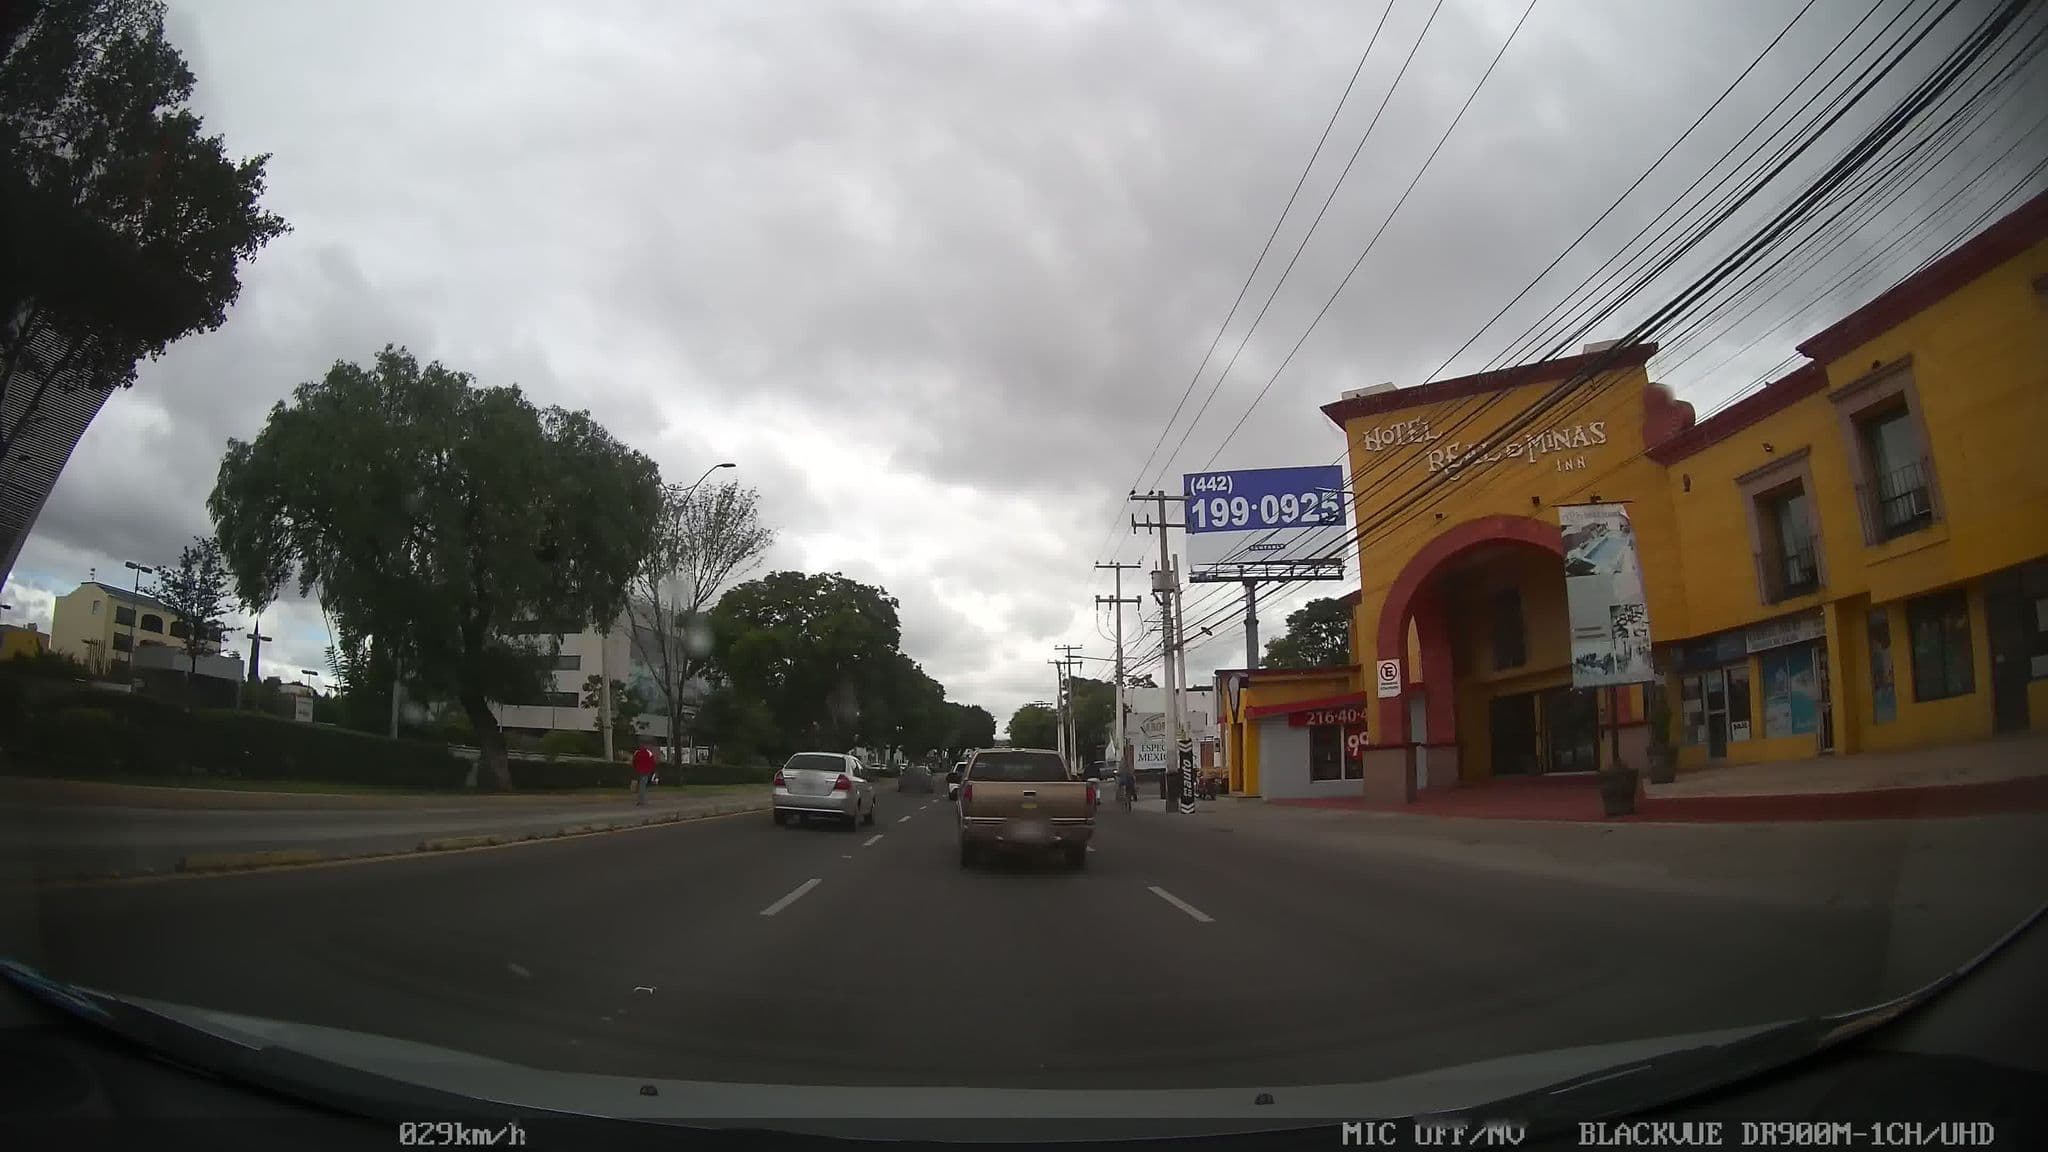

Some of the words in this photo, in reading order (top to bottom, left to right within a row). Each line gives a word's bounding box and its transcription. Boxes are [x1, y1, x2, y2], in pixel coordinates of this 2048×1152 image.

[1364, 415, 1443, 452] HOTEL
[1524, 421, 1608, 463] MINAS
[1556, 456, 1586, 472] INN
[1190, 475, 1233, 496] (442)
[1141, 744, 1168, 752] ESPEC
